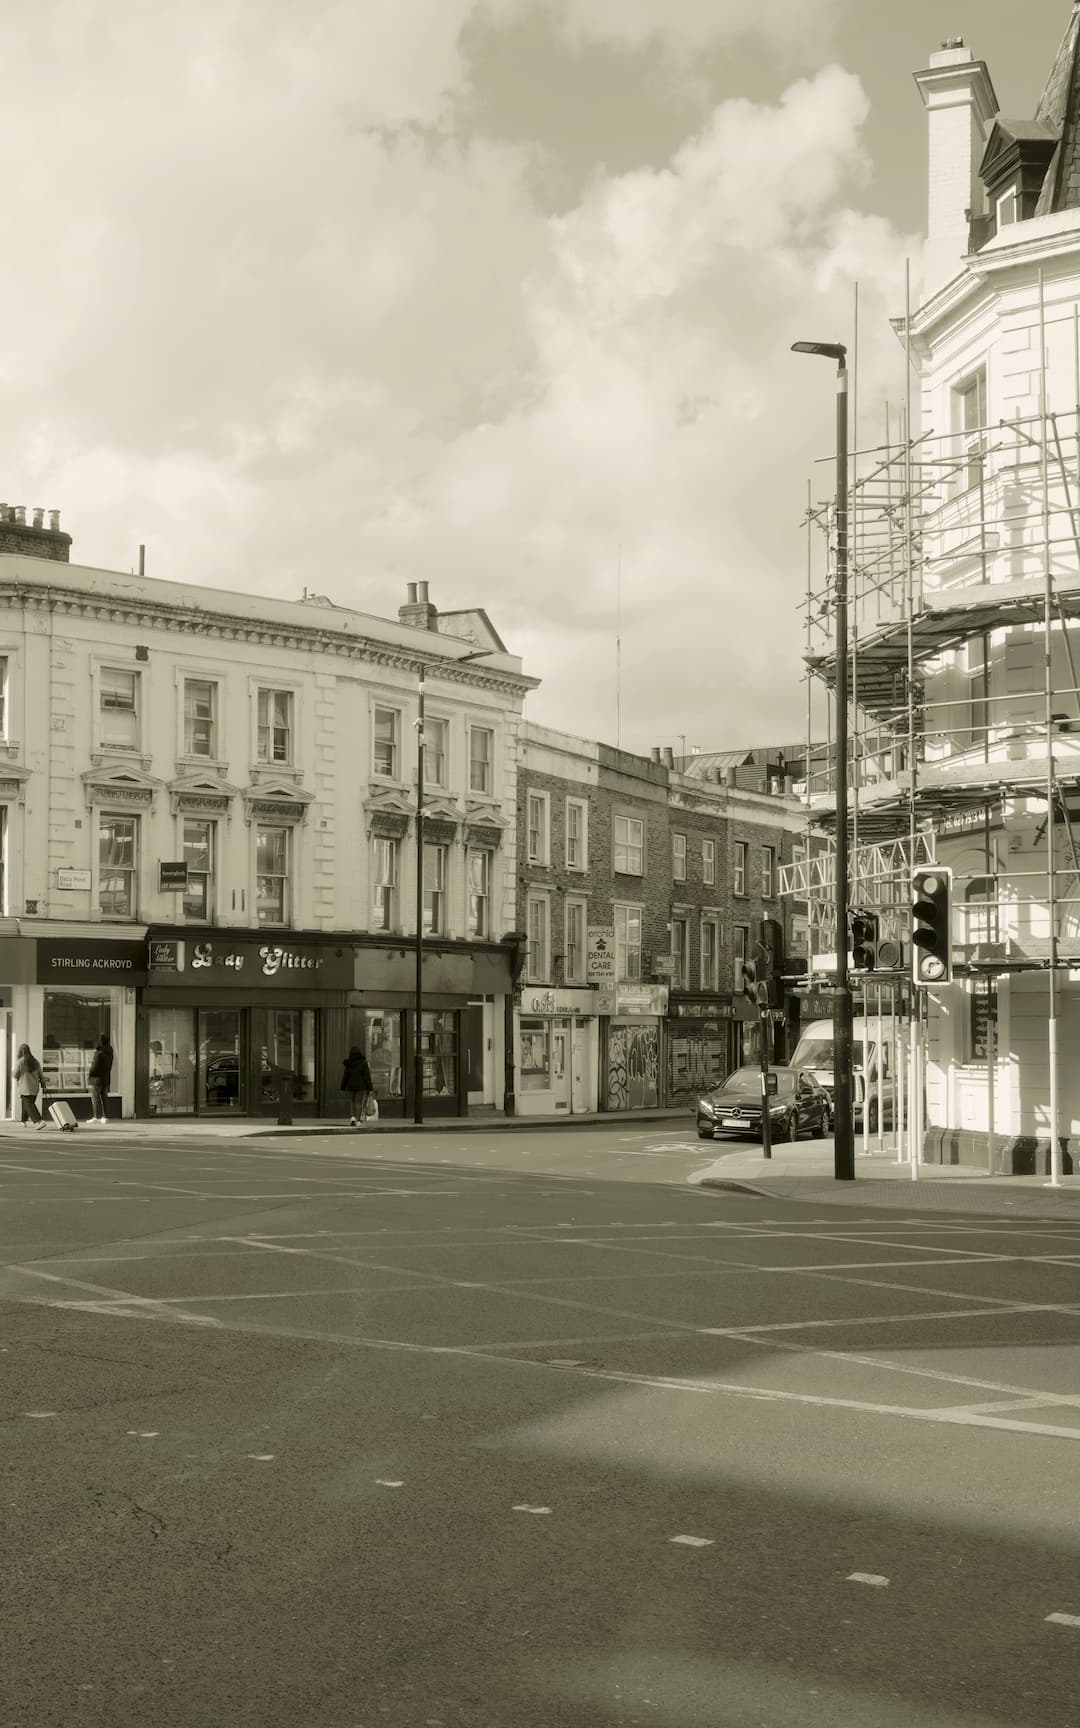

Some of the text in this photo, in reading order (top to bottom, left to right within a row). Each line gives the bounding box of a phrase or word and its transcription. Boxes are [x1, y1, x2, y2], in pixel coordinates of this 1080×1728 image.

[588, 928, 614, 938] orchid
[259, 946, 323, 975] Glitter
[588, 952, 615, 960] DENTAL
[51, 958, 133, 969] STIRLING ACKROYD
[591, 962, 612, 970] CARE
